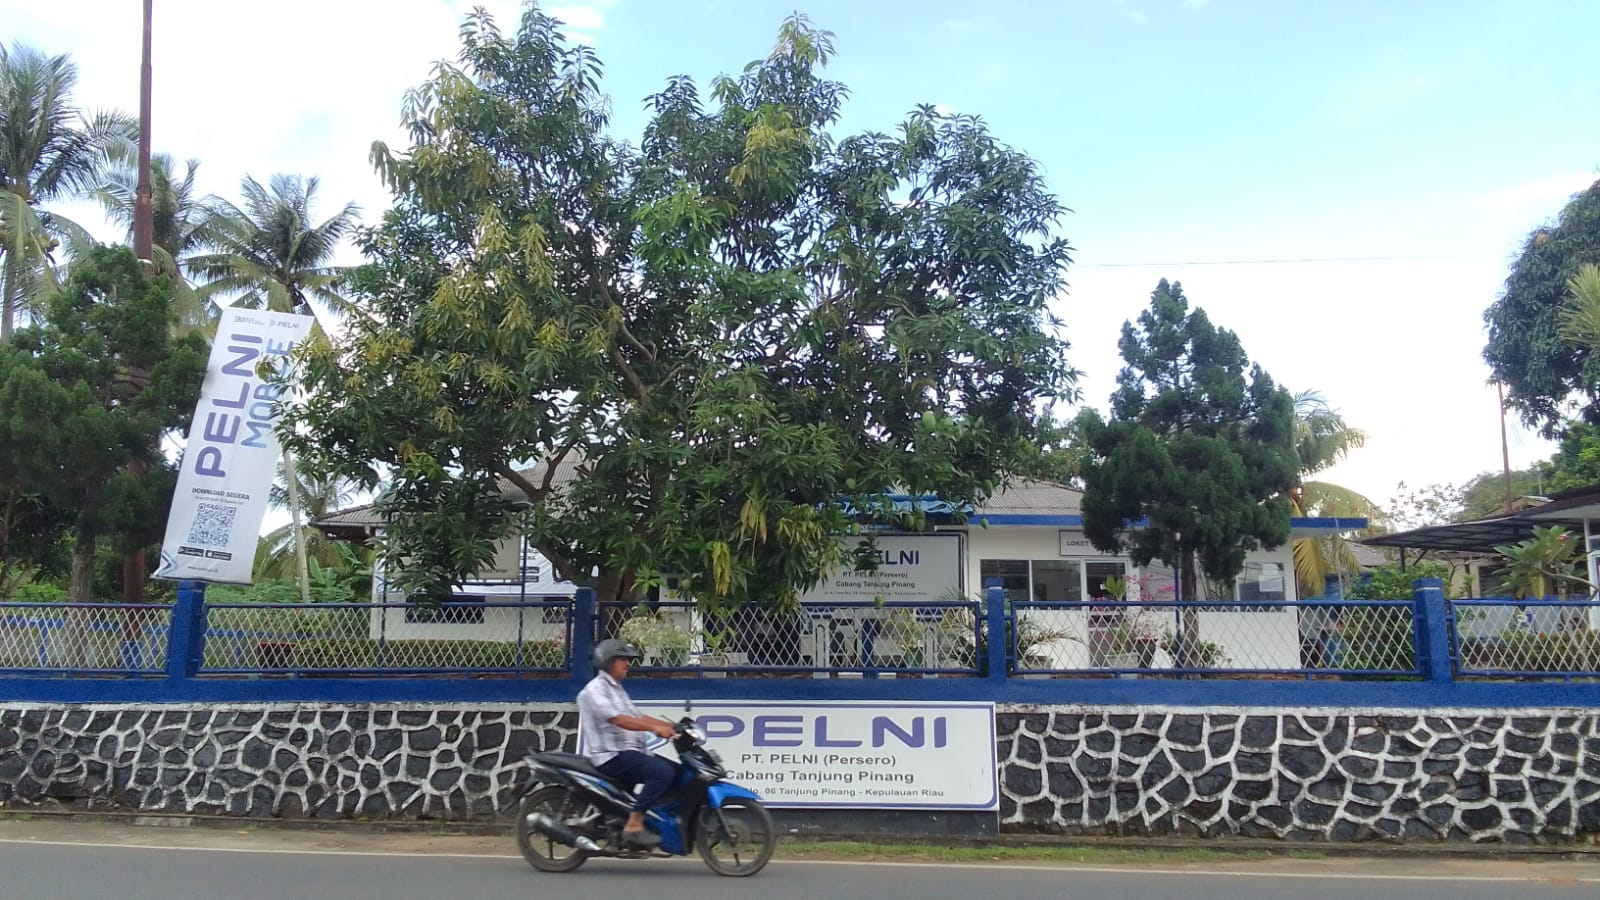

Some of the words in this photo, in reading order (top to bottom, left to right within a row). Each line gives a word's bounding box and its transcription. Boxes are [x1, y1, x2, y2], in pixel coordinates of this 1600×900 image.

[194, 333, 263, 478] PELNI
[192, 487, 225, 497] DOWNLOAD
[226, 491, 250, 501] SEGERA
[695, 715, 947, 748] PELNI
[741, 753, 764, 764] PT.
[770, 753, 819, 765] PELNI
[823, 754, 897, 768] (Persero)
[725, 769, 784, 783] Cabang
[789, 770, 853, 784] Tanjung
[858, 771, 914, 784] Pinang
[779, 787, 819, 797] Tanjung
[821, 787, 856, 797] Pinang
[865, 788, 919, 798] Kepulauan
[921, 788, 944, 797] Riau
